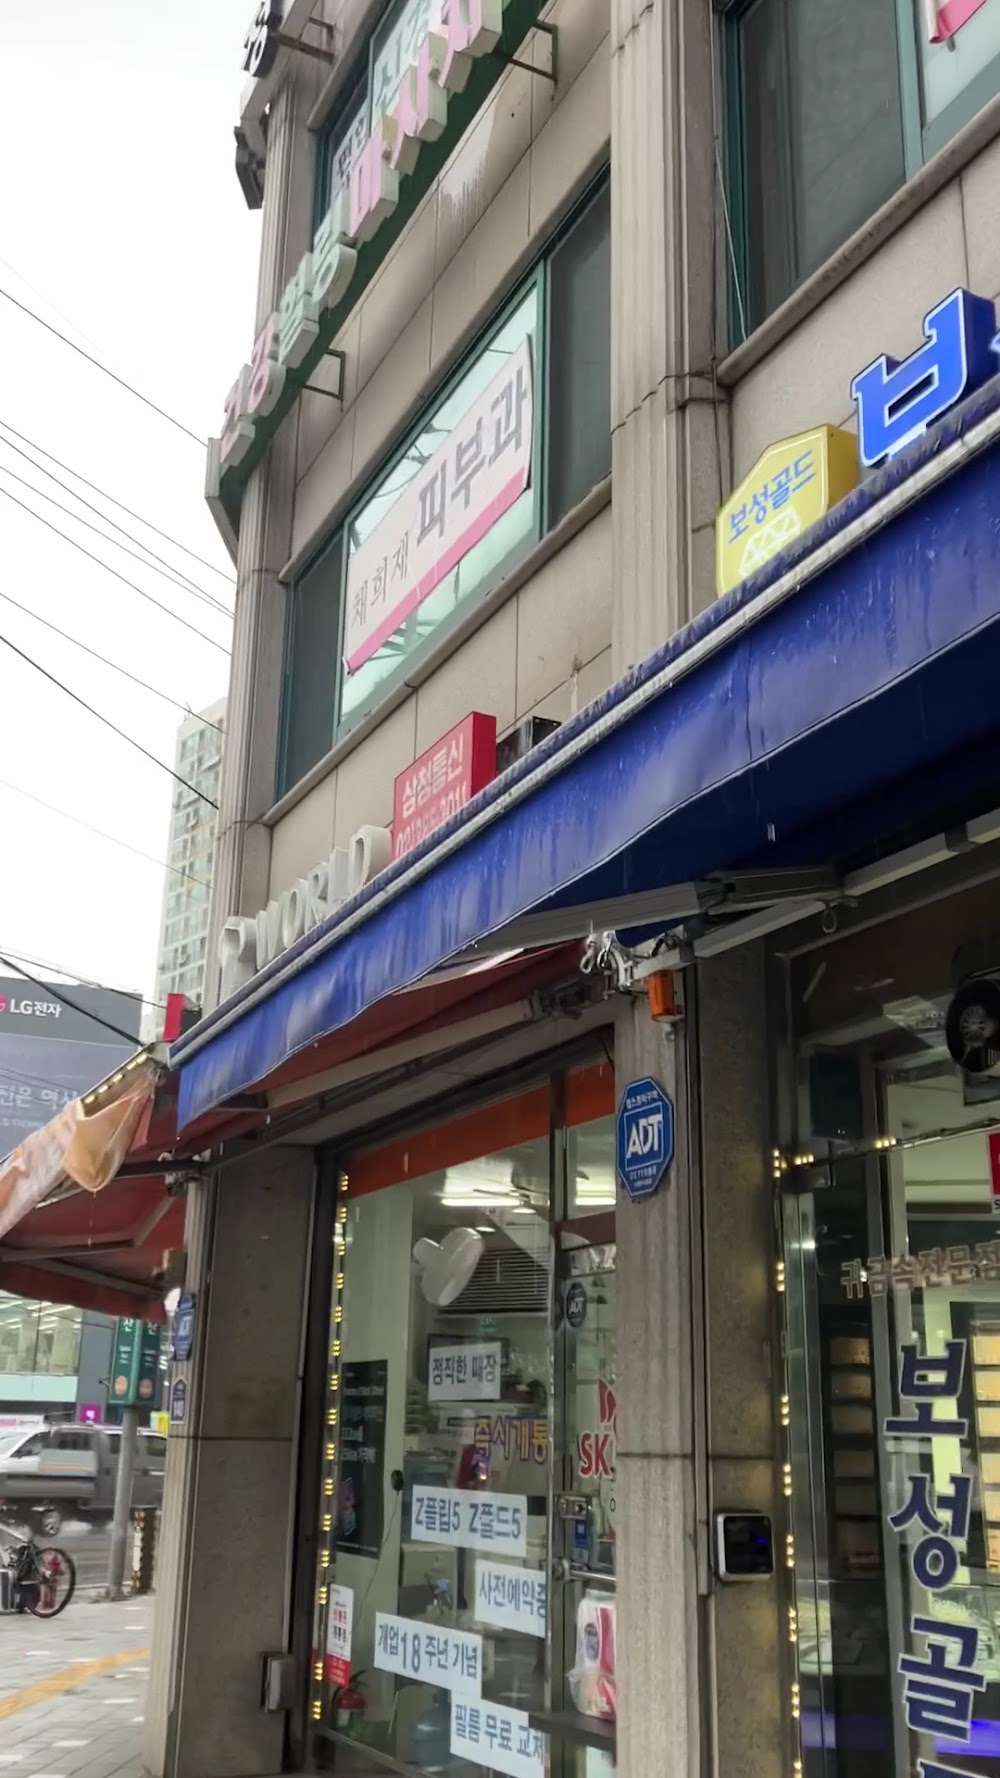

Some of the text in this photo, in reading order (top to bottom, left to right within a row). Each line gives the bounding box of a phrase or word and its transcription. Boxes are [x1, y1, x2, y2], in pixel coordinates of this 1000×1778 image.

[416, 367, 527, 547] 피부과
[728, 449, 816, 544] 보성골드
[10, 998, 62, 1018] LG전자
[625, 1113, 663, 1159] ADT
[432, 1354, 496, 1386] 정직한 매장
[576, 1429, 612, 1479] SK
[415, 1496, 522, 1540] Z플립5 Z폴드5
[883, 1339, 987, 1778] 보성골
[452, 1642, 478, 1681] 기념
[455, 1703, 480, 1745] 필름
[484, 1713, 513, 1752] 무료
